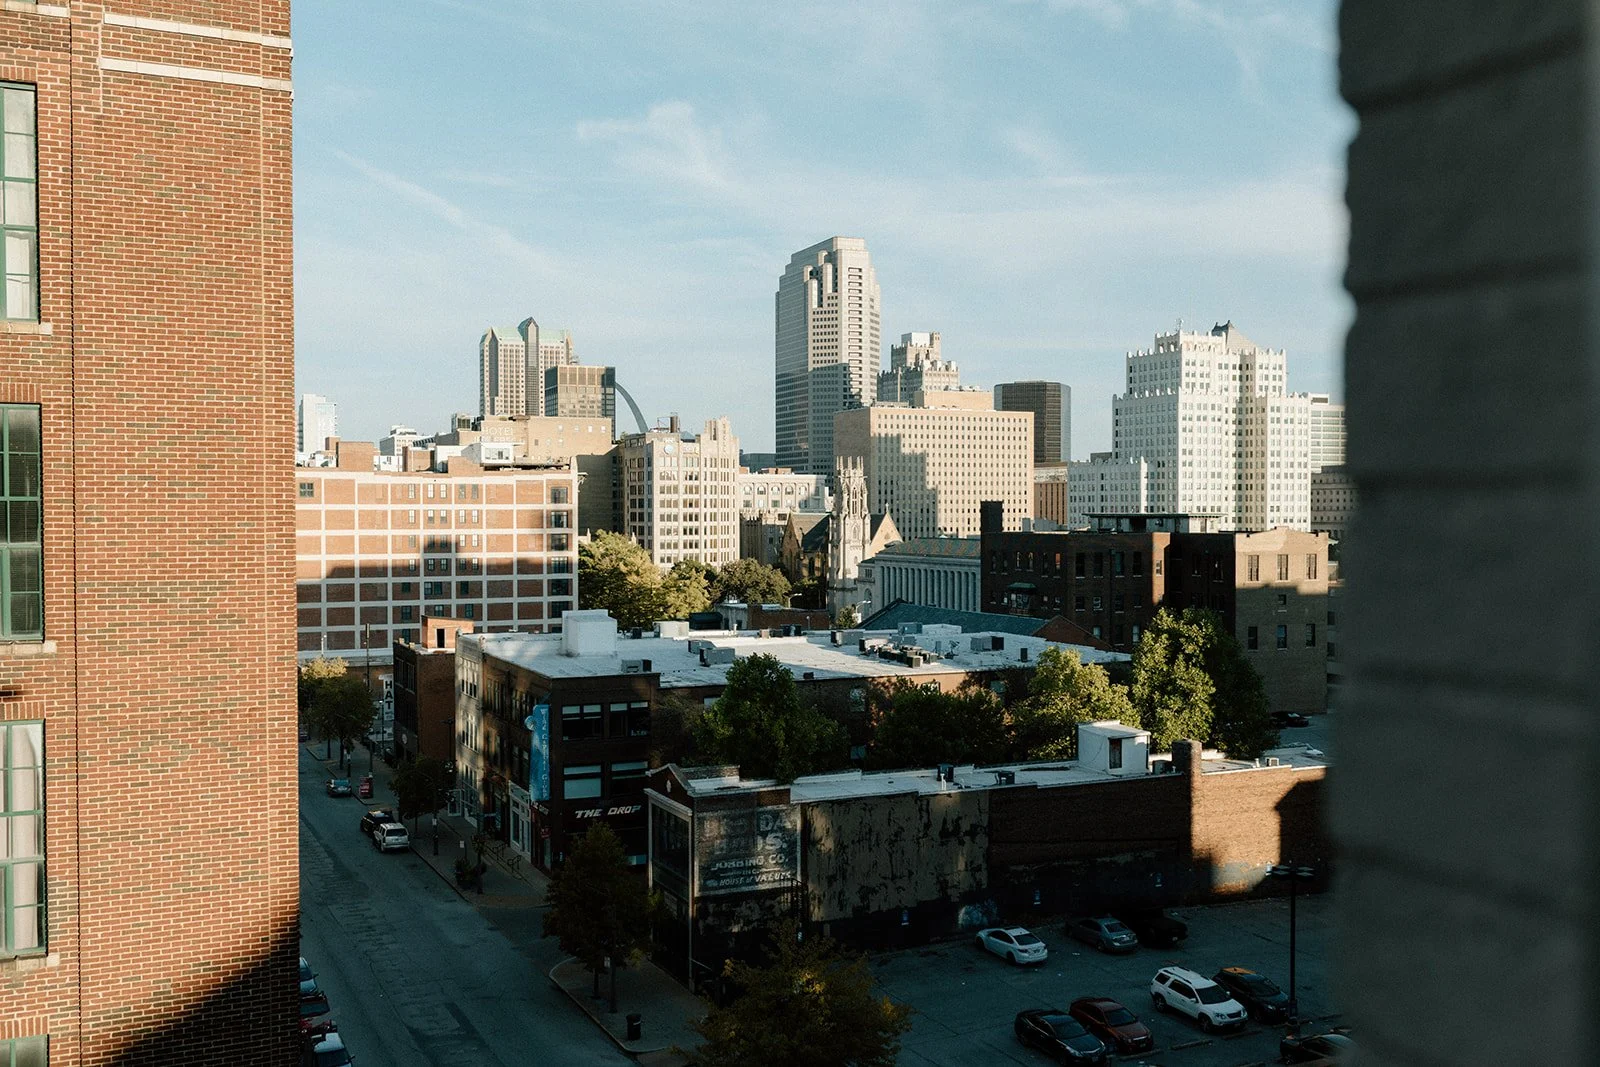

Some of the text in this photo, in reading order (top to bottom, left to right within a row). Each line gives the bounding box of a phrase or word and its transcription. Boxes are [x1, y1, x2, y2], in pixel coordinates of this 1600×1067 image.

[385, 680, 393, 710] HAT
[575, 804, 641, 819] THE DROP
[711, 855, 764, 871] JOBBING
[754, 871, 792, 883] VALUES
